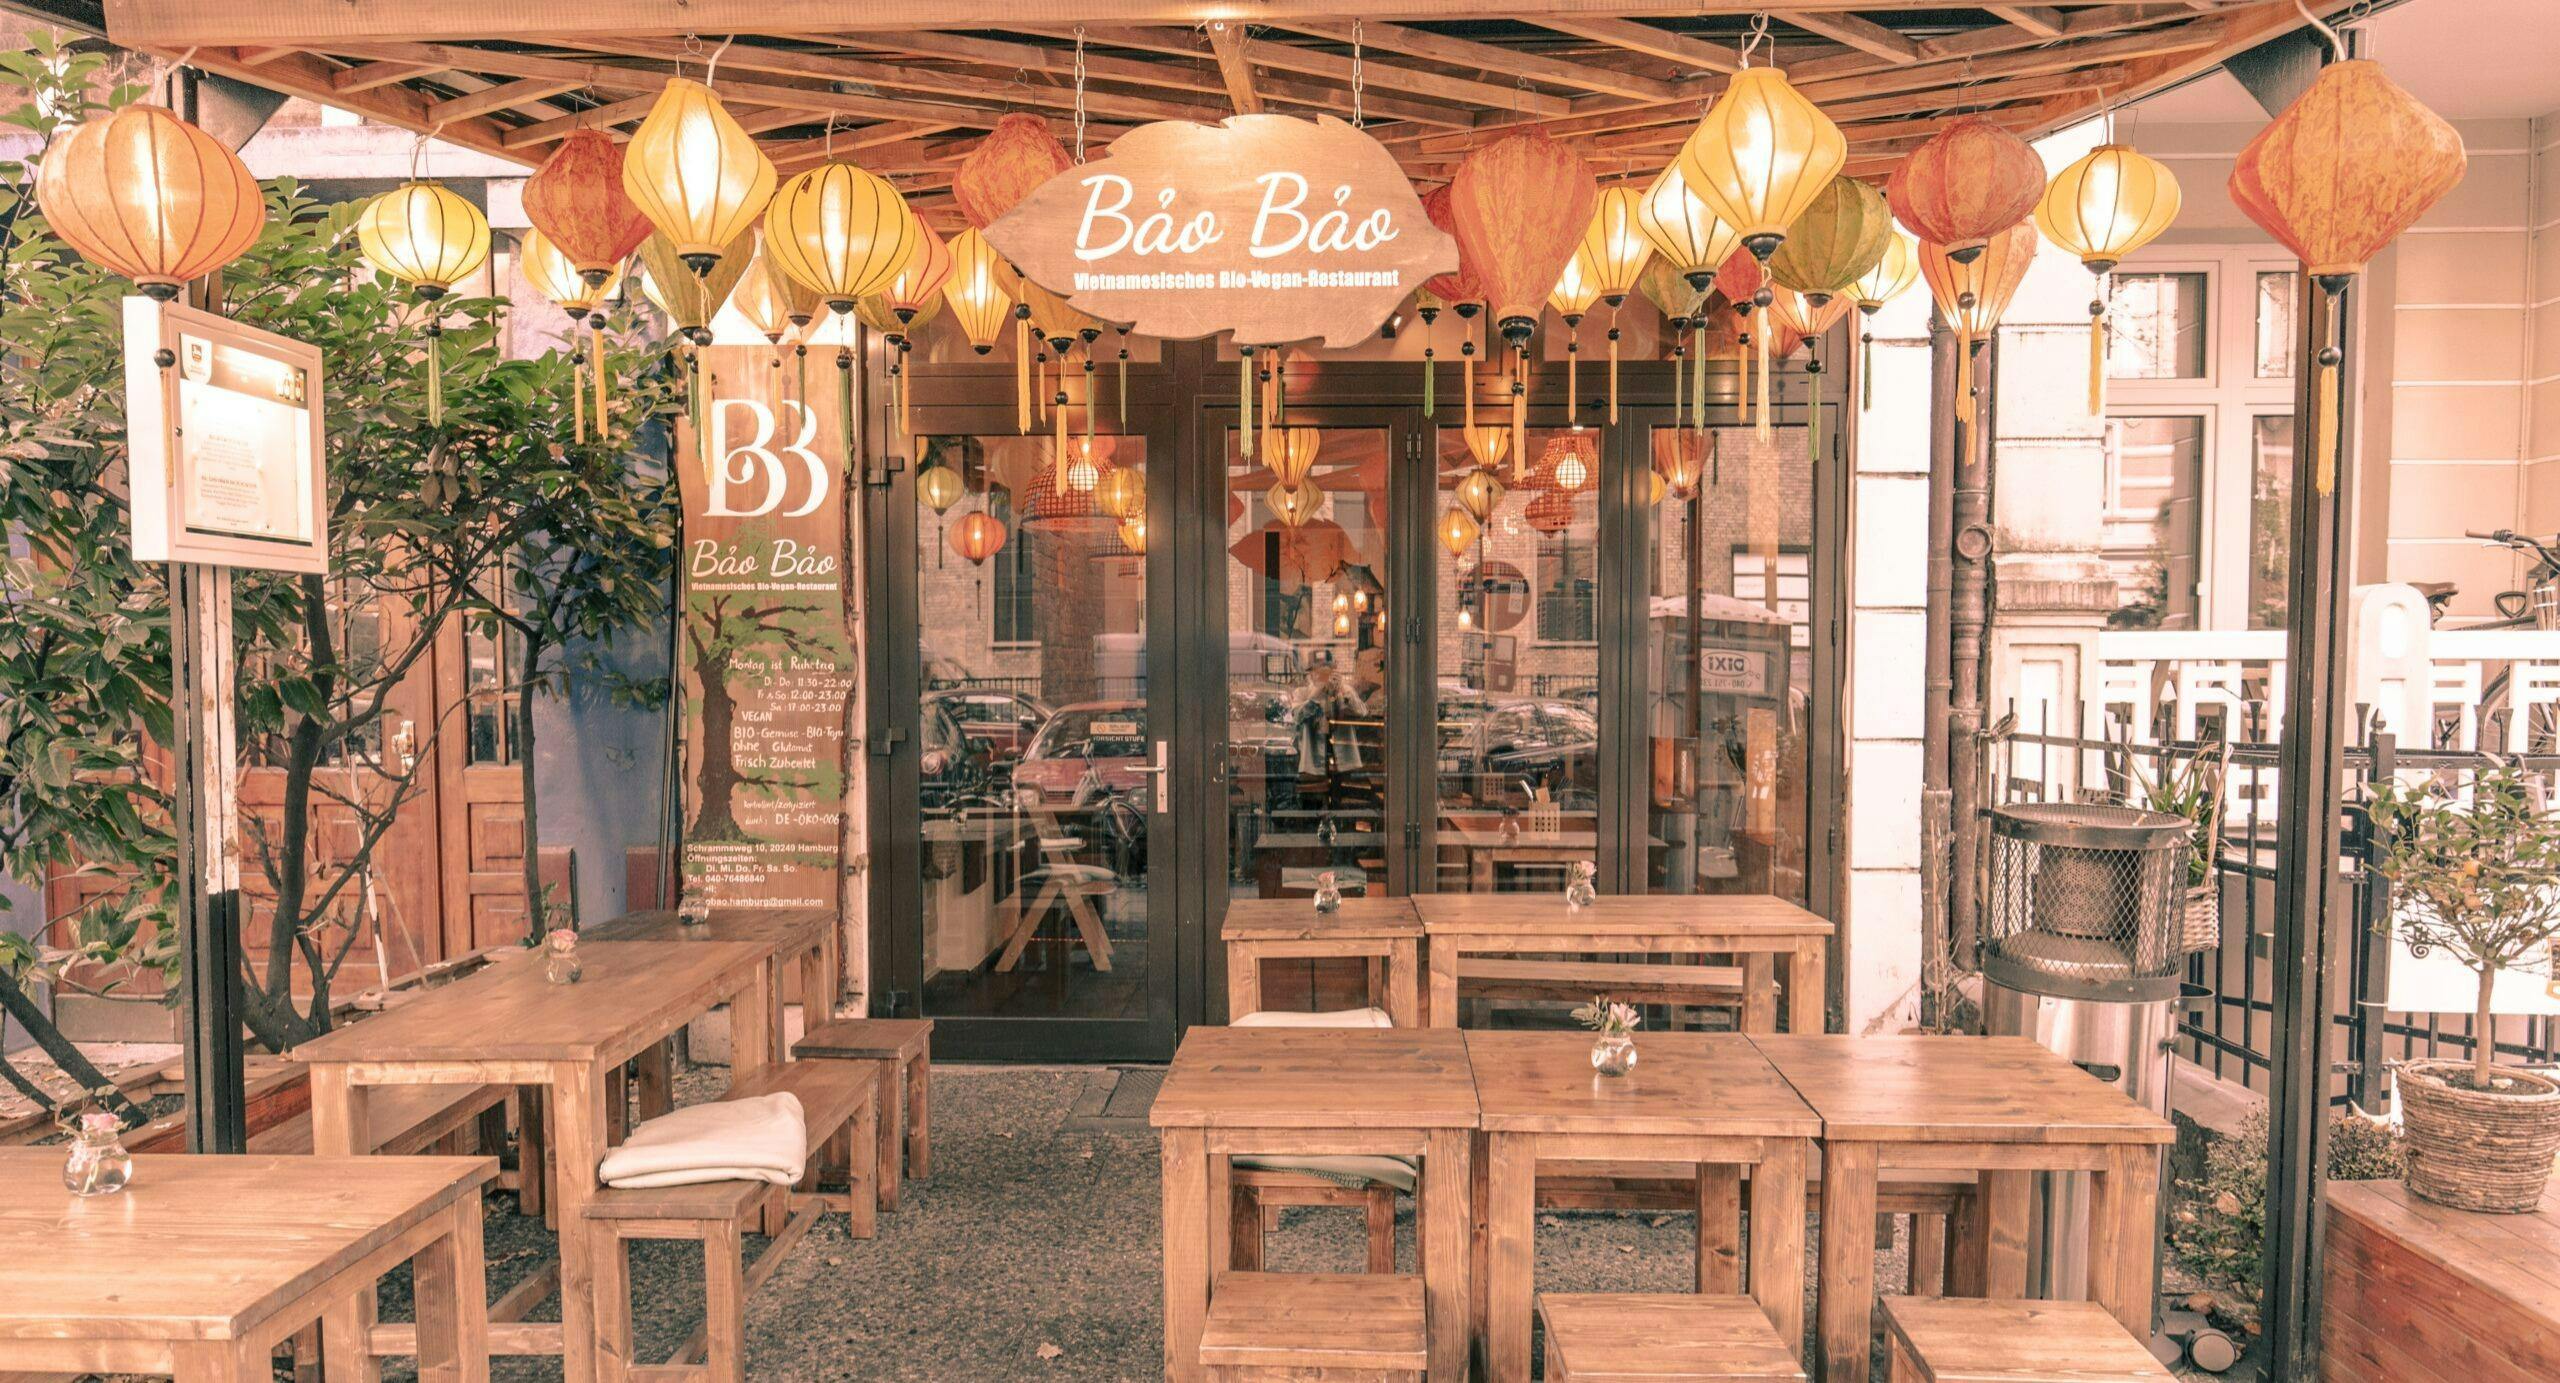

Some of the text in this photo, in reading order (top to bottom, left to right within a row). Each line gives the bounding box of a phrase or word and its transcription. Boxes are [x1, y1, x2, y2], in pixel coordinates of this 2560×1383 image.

[1074, 171, 1399, 260] Bảo Bảo
[1074, 269, 1399, 291] Vietnamesisches Bio-Vegan-Restaurant
[691, 538, 838, 578] Bảo Bảo
[691, 582, 838, 592] Vietnamesisches Bio-Vegan-Restaurant
[729, 658, 765, 675] Montag
[771, 660, 783, 670] ist
[741, 711, 773, 722] VEGAN
[733, 740, 760, 751] ohne
[734, 754, 766, 768] Frisch
[687, 844, 753, 854] Schrammsweg
[798, 844, 839, 854] Hamburg
[687, 853, 758, 864] Öffnungszeiten:
[705, 864, 798, 873] Di. Mi. Do. Fr. Sa. So.
[688, 875, 702, 883] Tel.
